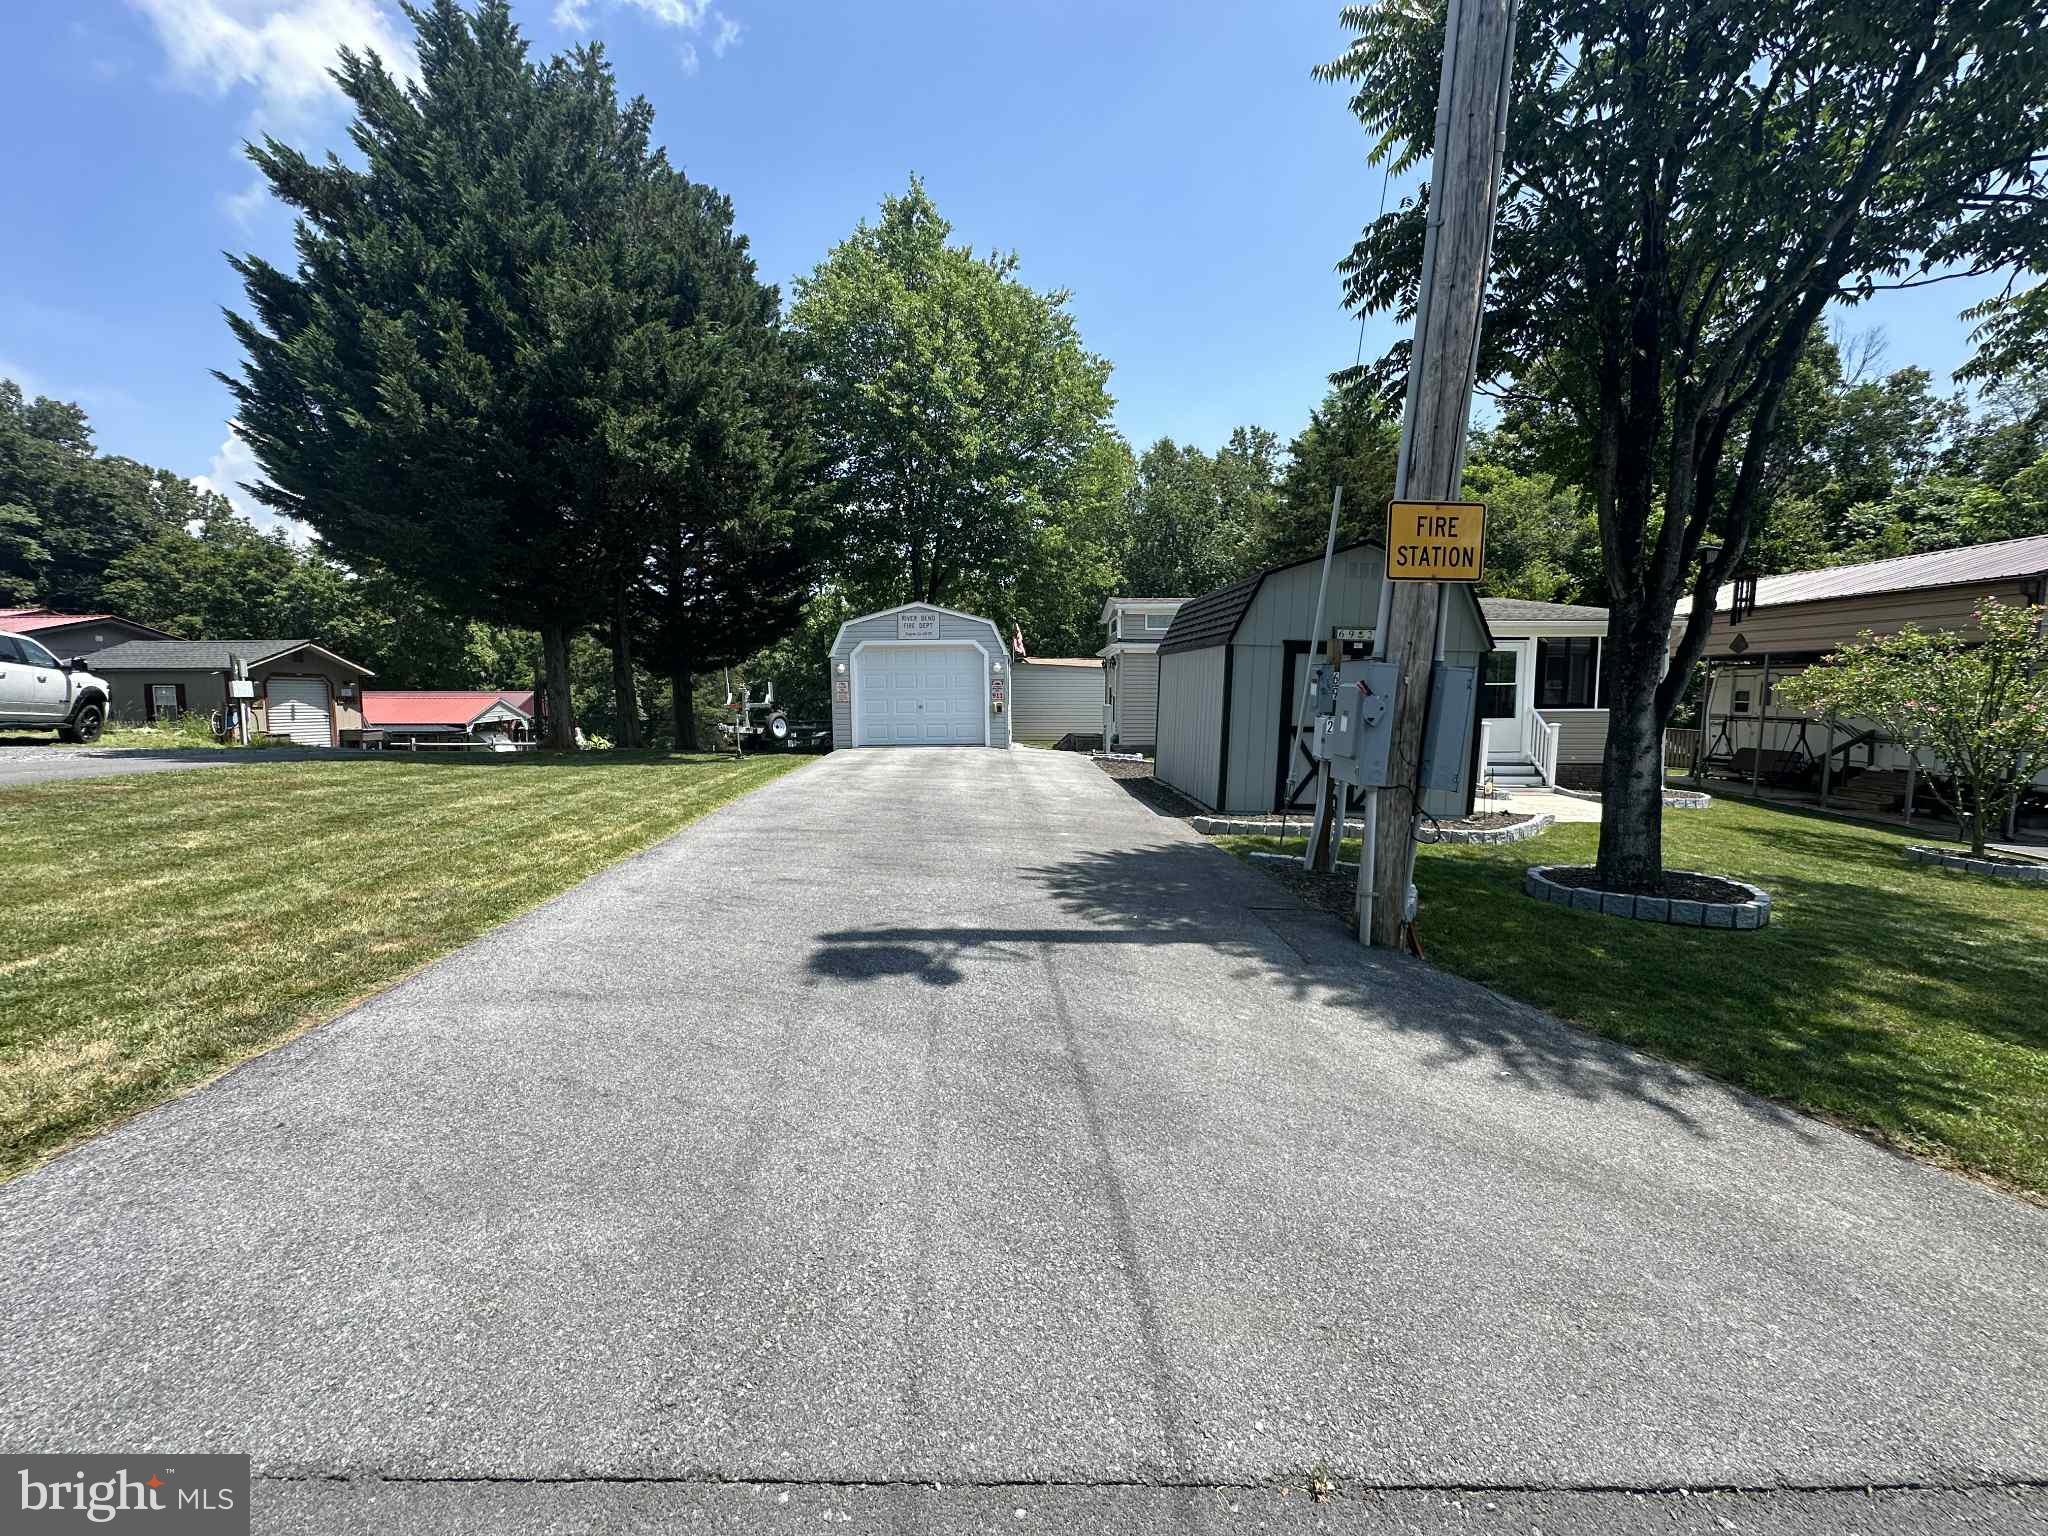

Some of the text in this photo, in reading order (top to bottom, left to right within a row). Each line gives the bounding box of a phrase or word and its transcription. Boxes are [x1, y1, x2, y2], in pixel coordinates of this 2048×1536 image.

[1416, 516, 1459, 537] FIRE
[1396, 545, 1474, 567] STATION
[1327, 720, 1333, 733] 2
